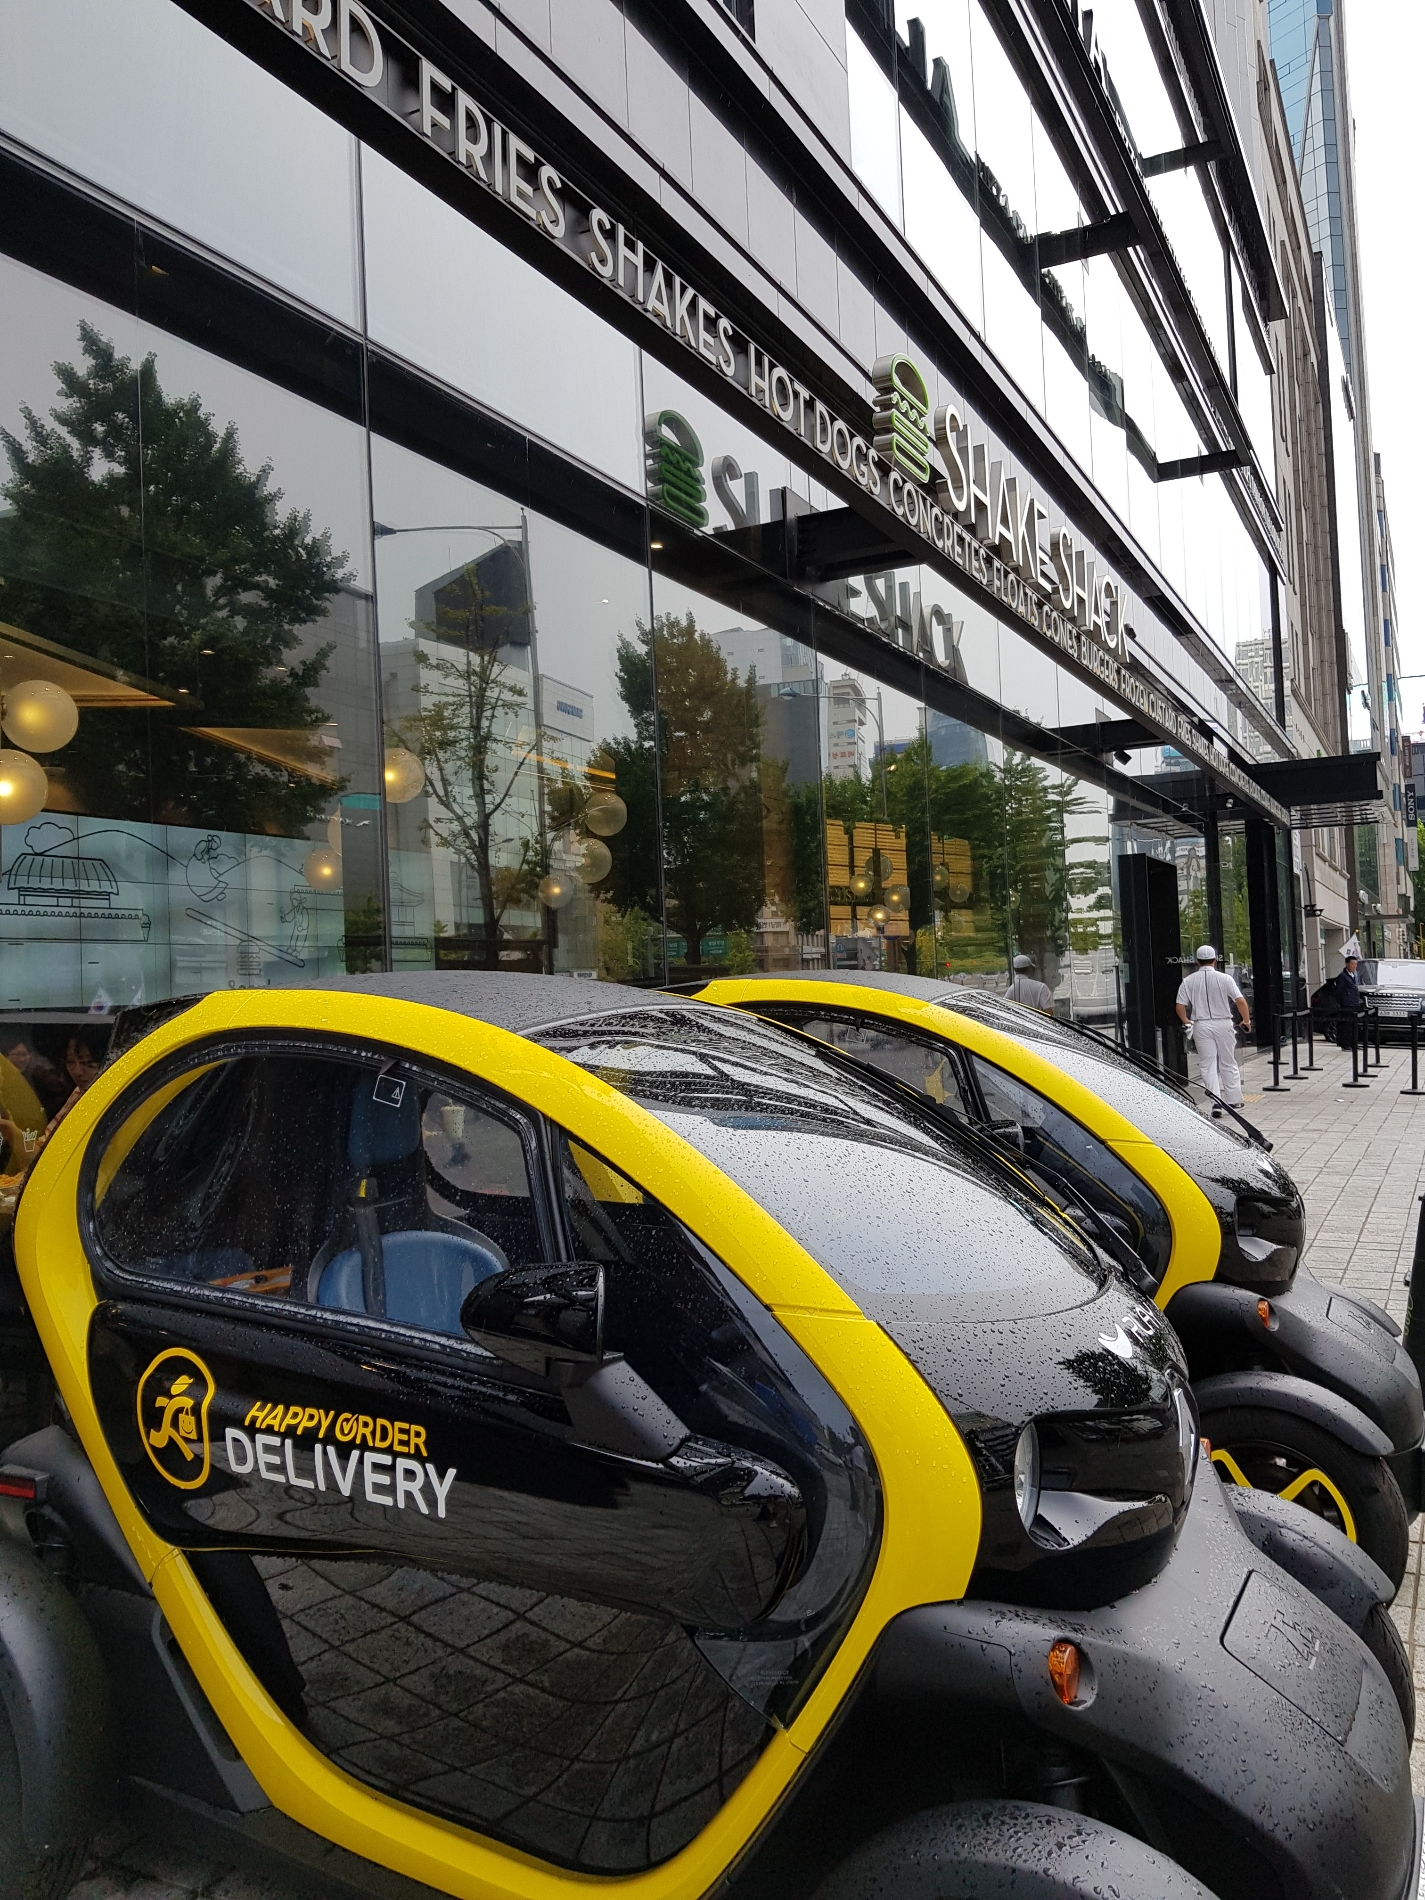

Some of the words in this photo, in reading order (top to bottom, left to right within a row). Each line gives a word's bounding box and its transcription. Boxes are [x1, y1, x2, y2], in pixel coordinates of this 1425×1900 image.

[418, 58, 566, 239] FRIES
[588, 207, 736, 378] SHAKES
[748, 343, 810, 437] HOT
[814, 400, 881, 496] DOGS
[888, 471, 988, 586] CONCRETES
[993, 558, 1039, 628] FLOATS
[1041, 604, 1078, 660] CONES
[1081, 634, 1119, 690] BURGERS
[1120, 669, 1149, 714] FROZEN
[1149, 692, 1177, 734] CUSTARD
[936, 403, 1053, 595] SHAKE
[1052, 525, 1130, 663] SHACK
[1407, 789, 1416, 821] SONY
[224, 1427, 457, 1519] DELIVERY
[244, 1401, 335, 1439] HAPPY
[335, 1412, 428, 1457] ORDER
